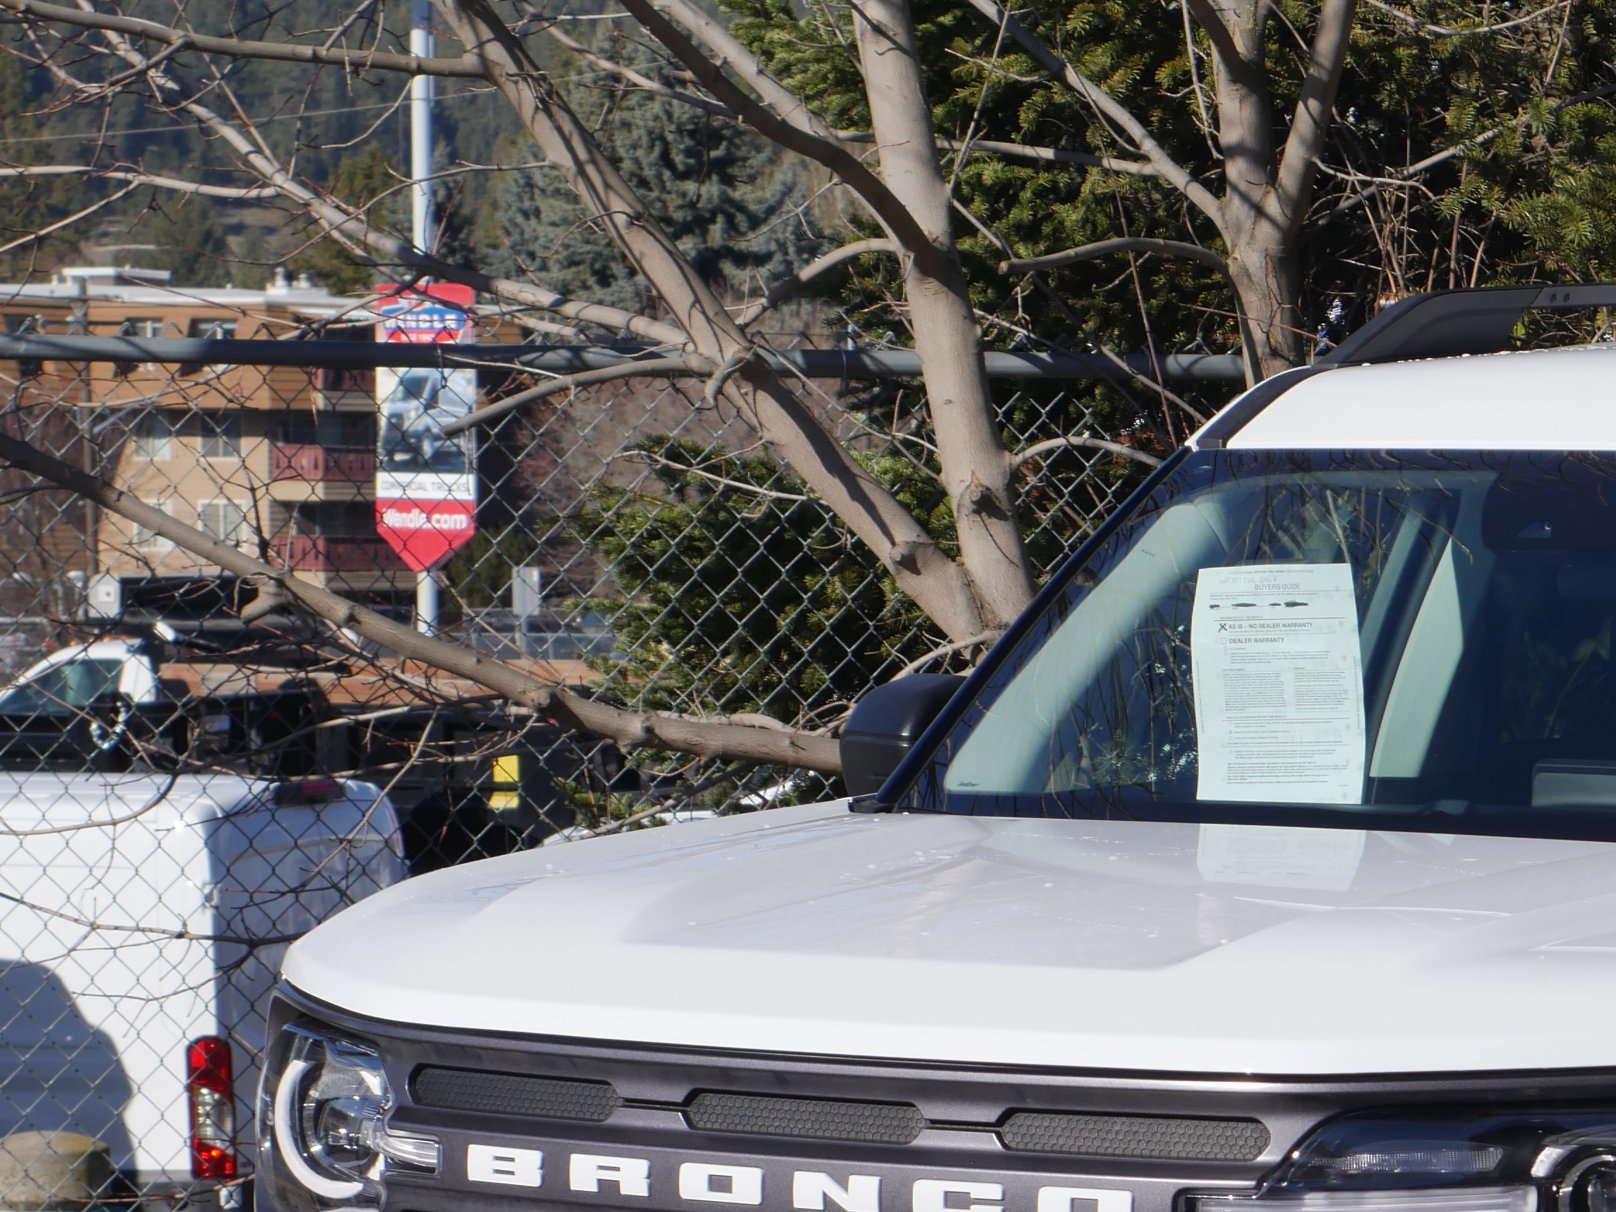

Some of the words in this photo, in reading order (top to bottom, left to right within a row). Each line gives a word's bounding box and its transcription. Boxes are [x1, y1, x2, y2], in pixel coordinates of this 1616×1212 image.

[384, 314, 457, 329] WENDLE
[382, 508, 468, 530] Wendle.com
[1255, 583, 1281, 591] BUYERS
